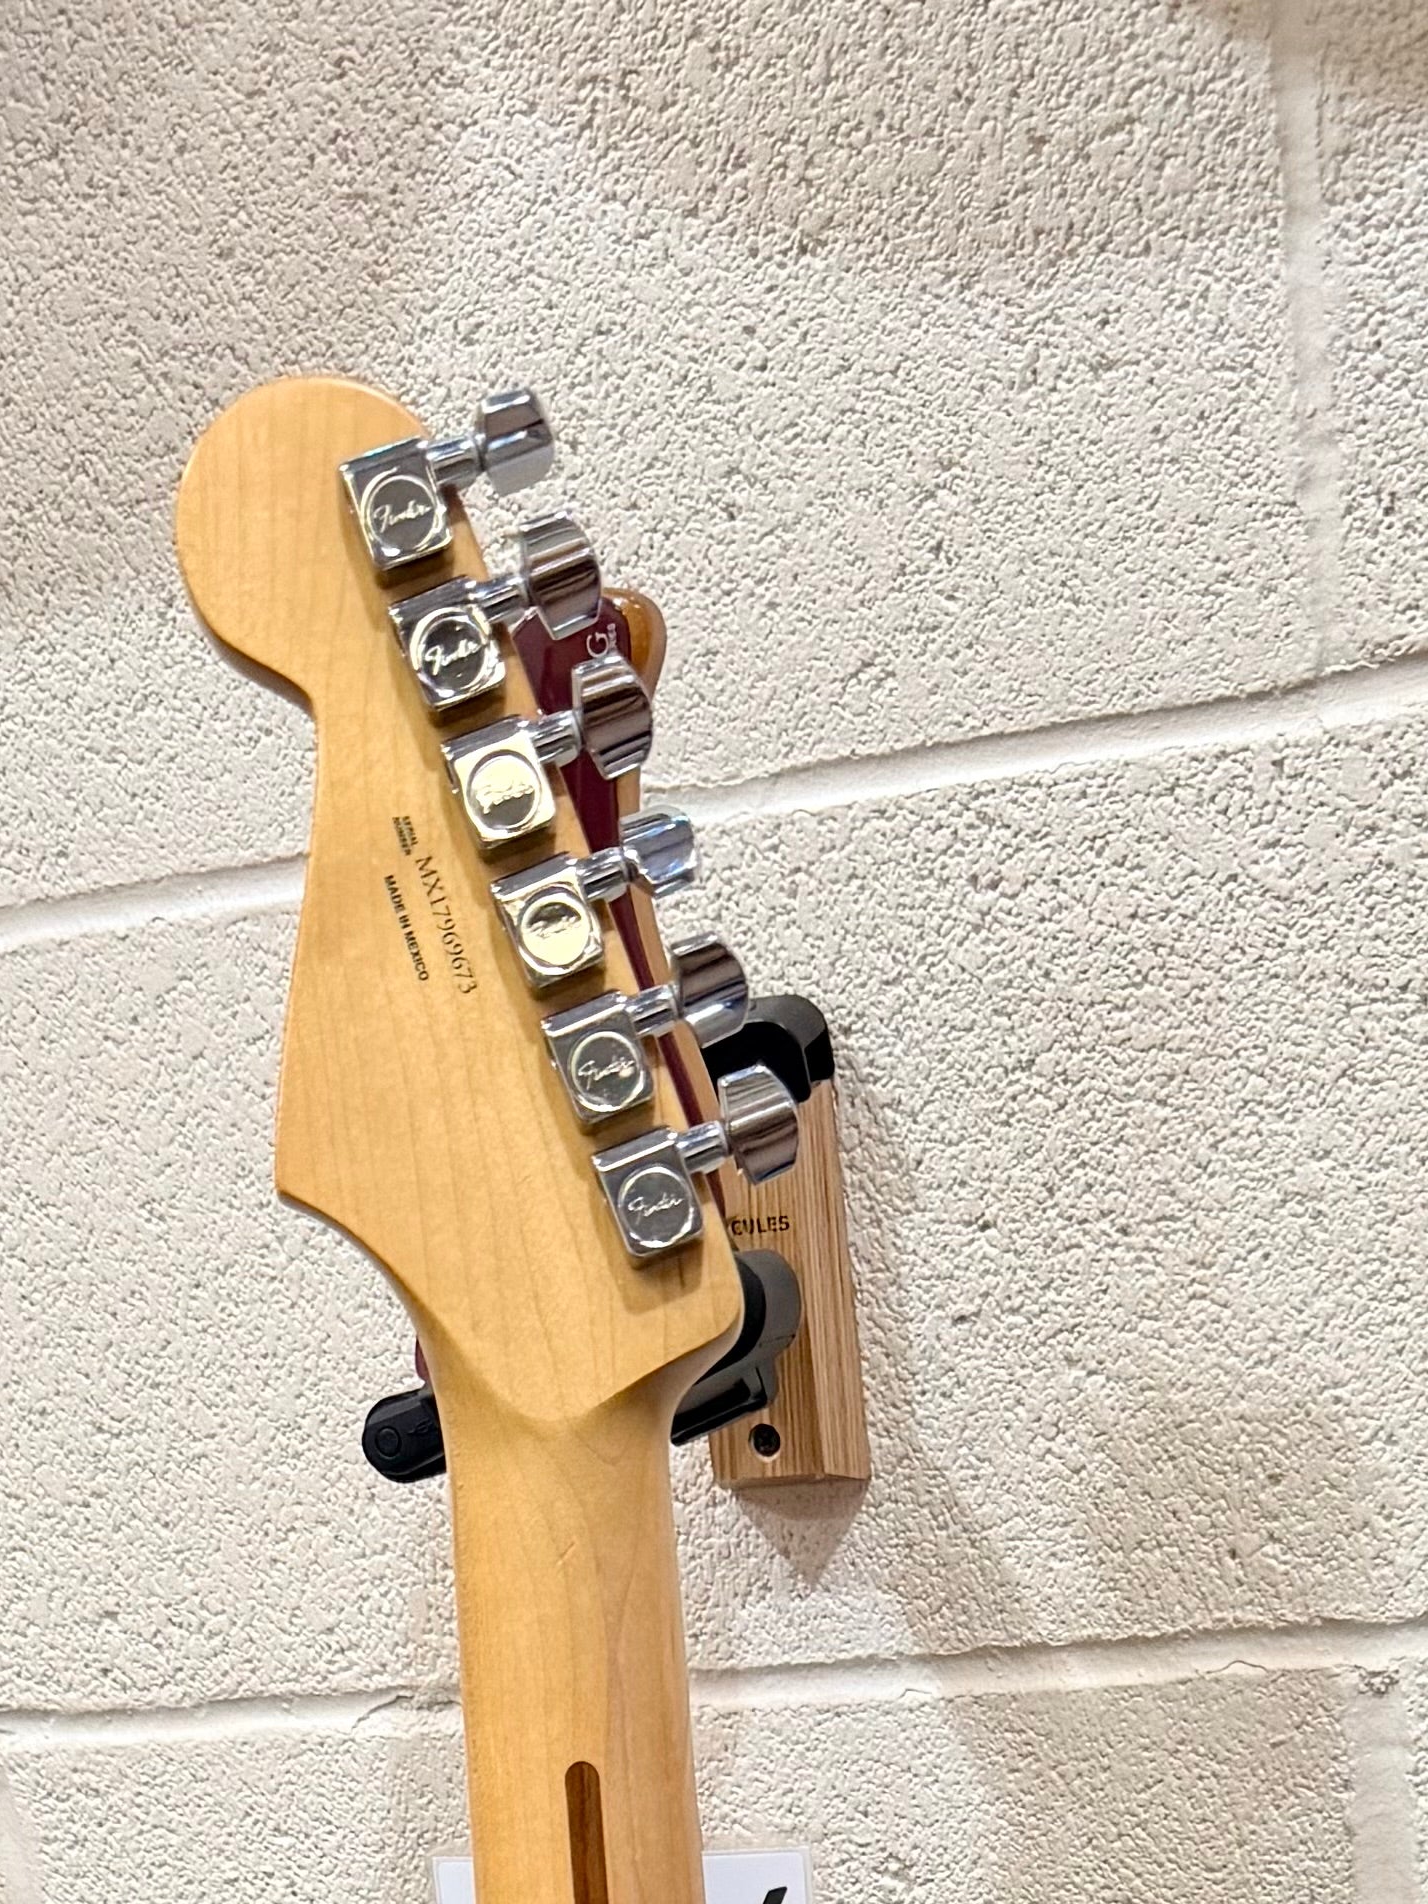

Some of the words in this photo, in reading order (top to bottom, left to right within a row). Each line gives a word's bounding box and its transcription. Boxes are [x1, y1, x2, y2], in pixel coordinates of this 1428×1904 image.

[384, 874, 403, 915] MADE
[398, 912, 413, 930] IN
[415, 855, 478, 995] MX17969673
[404, 930, 429, 982] MEXICO
[728, 1215, 791, 1236] CULES
